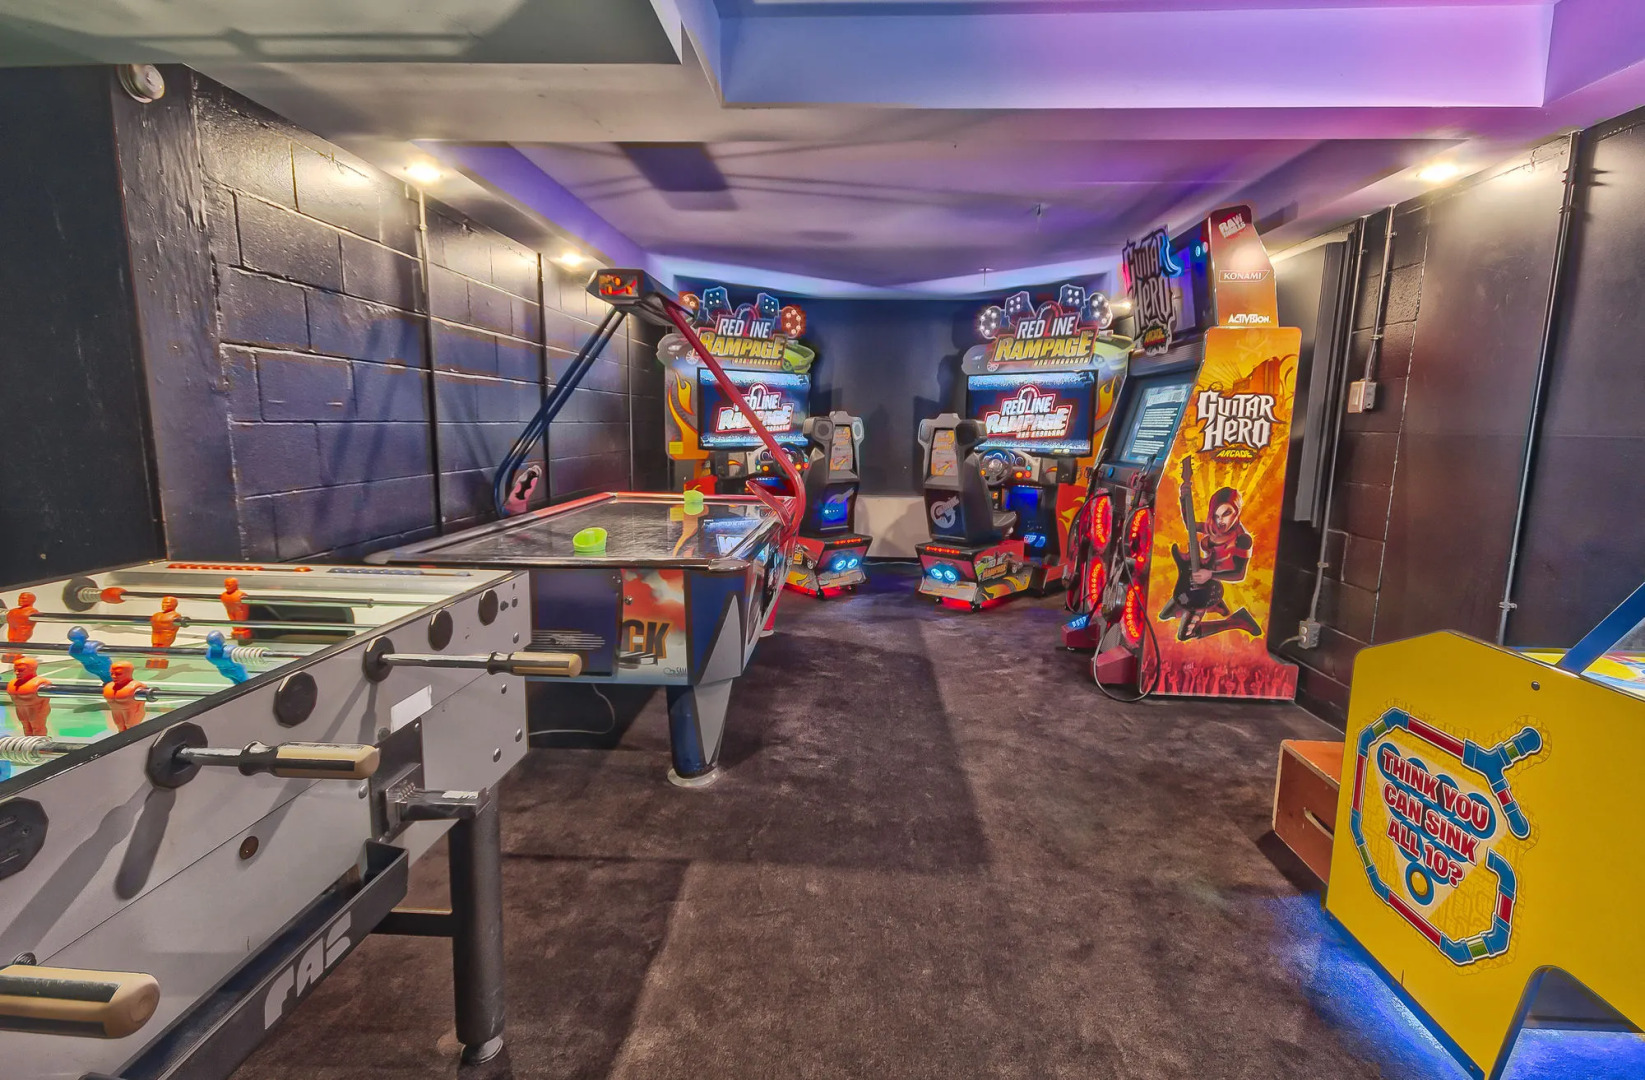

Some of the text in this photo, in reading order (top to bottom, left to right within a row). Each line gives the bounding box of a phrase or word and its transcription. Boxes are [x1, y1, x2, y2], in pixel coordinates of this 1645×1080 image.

[1223, 272, 1262, 280] KONAMI
[699, 332, 787, 359] RAMPAGE
[994, 330, 1095, 362] RAMPAGE
[985, 407, 1069, 434] RAMPAGE
[1216, 449, 1254, 459] ARCADE
[1382, 747, 1490, 831] THINK YOU
[1383, 782, 1481, 867] CAN SINK
[1386, 816, 1466, 889] ALL 10?
